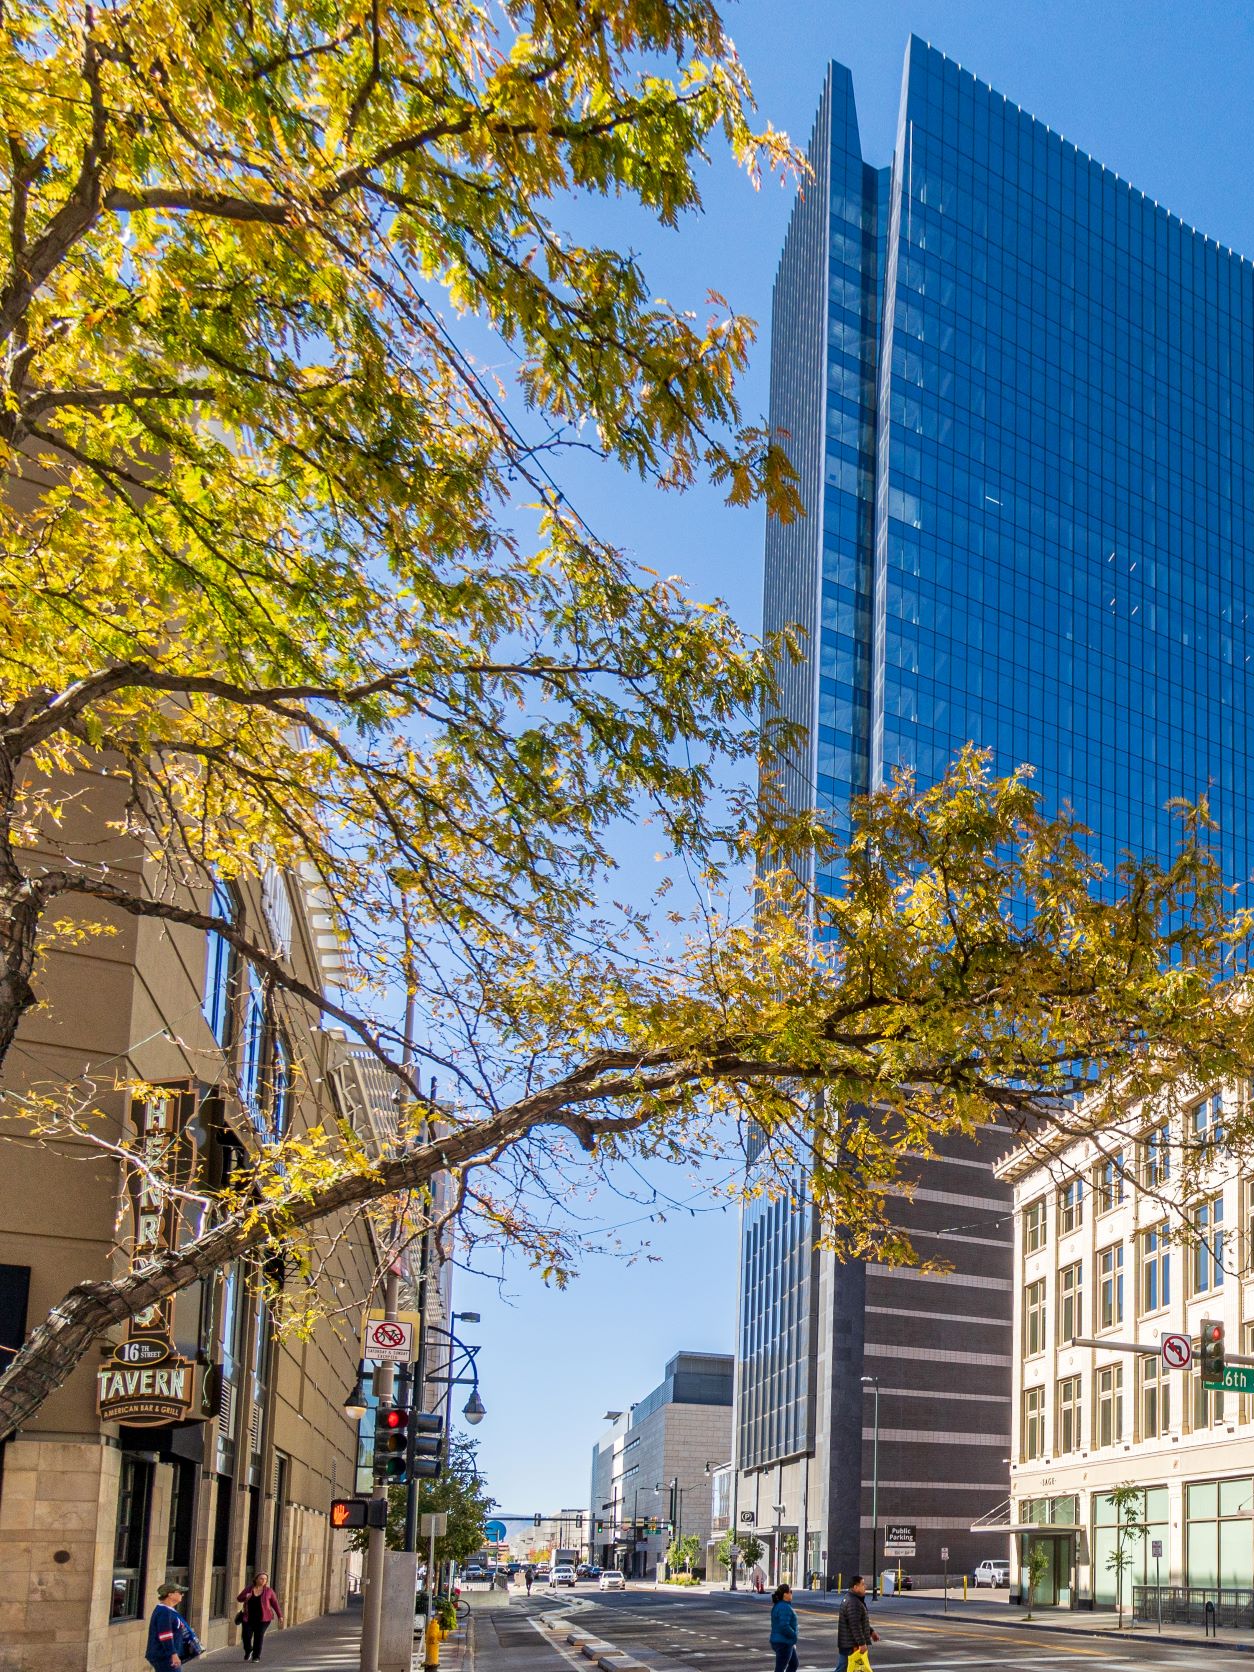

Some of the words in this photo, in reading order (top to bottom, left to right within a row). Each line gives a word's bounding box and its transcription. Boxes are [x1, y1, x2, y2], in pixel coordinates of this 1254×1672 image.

[123, 1344, 139, 1361] 16
[98, 1369, 185, 1401] TAVERN
[1221, 1371, 1247, 1387] 6th
[104, 1404, 139, 1417] AMERICAN
[140, 1404, 153, 1412] BAR
[154, 1404, 160, 1412] &
[160, 1405, 179, 1416] GRILL
